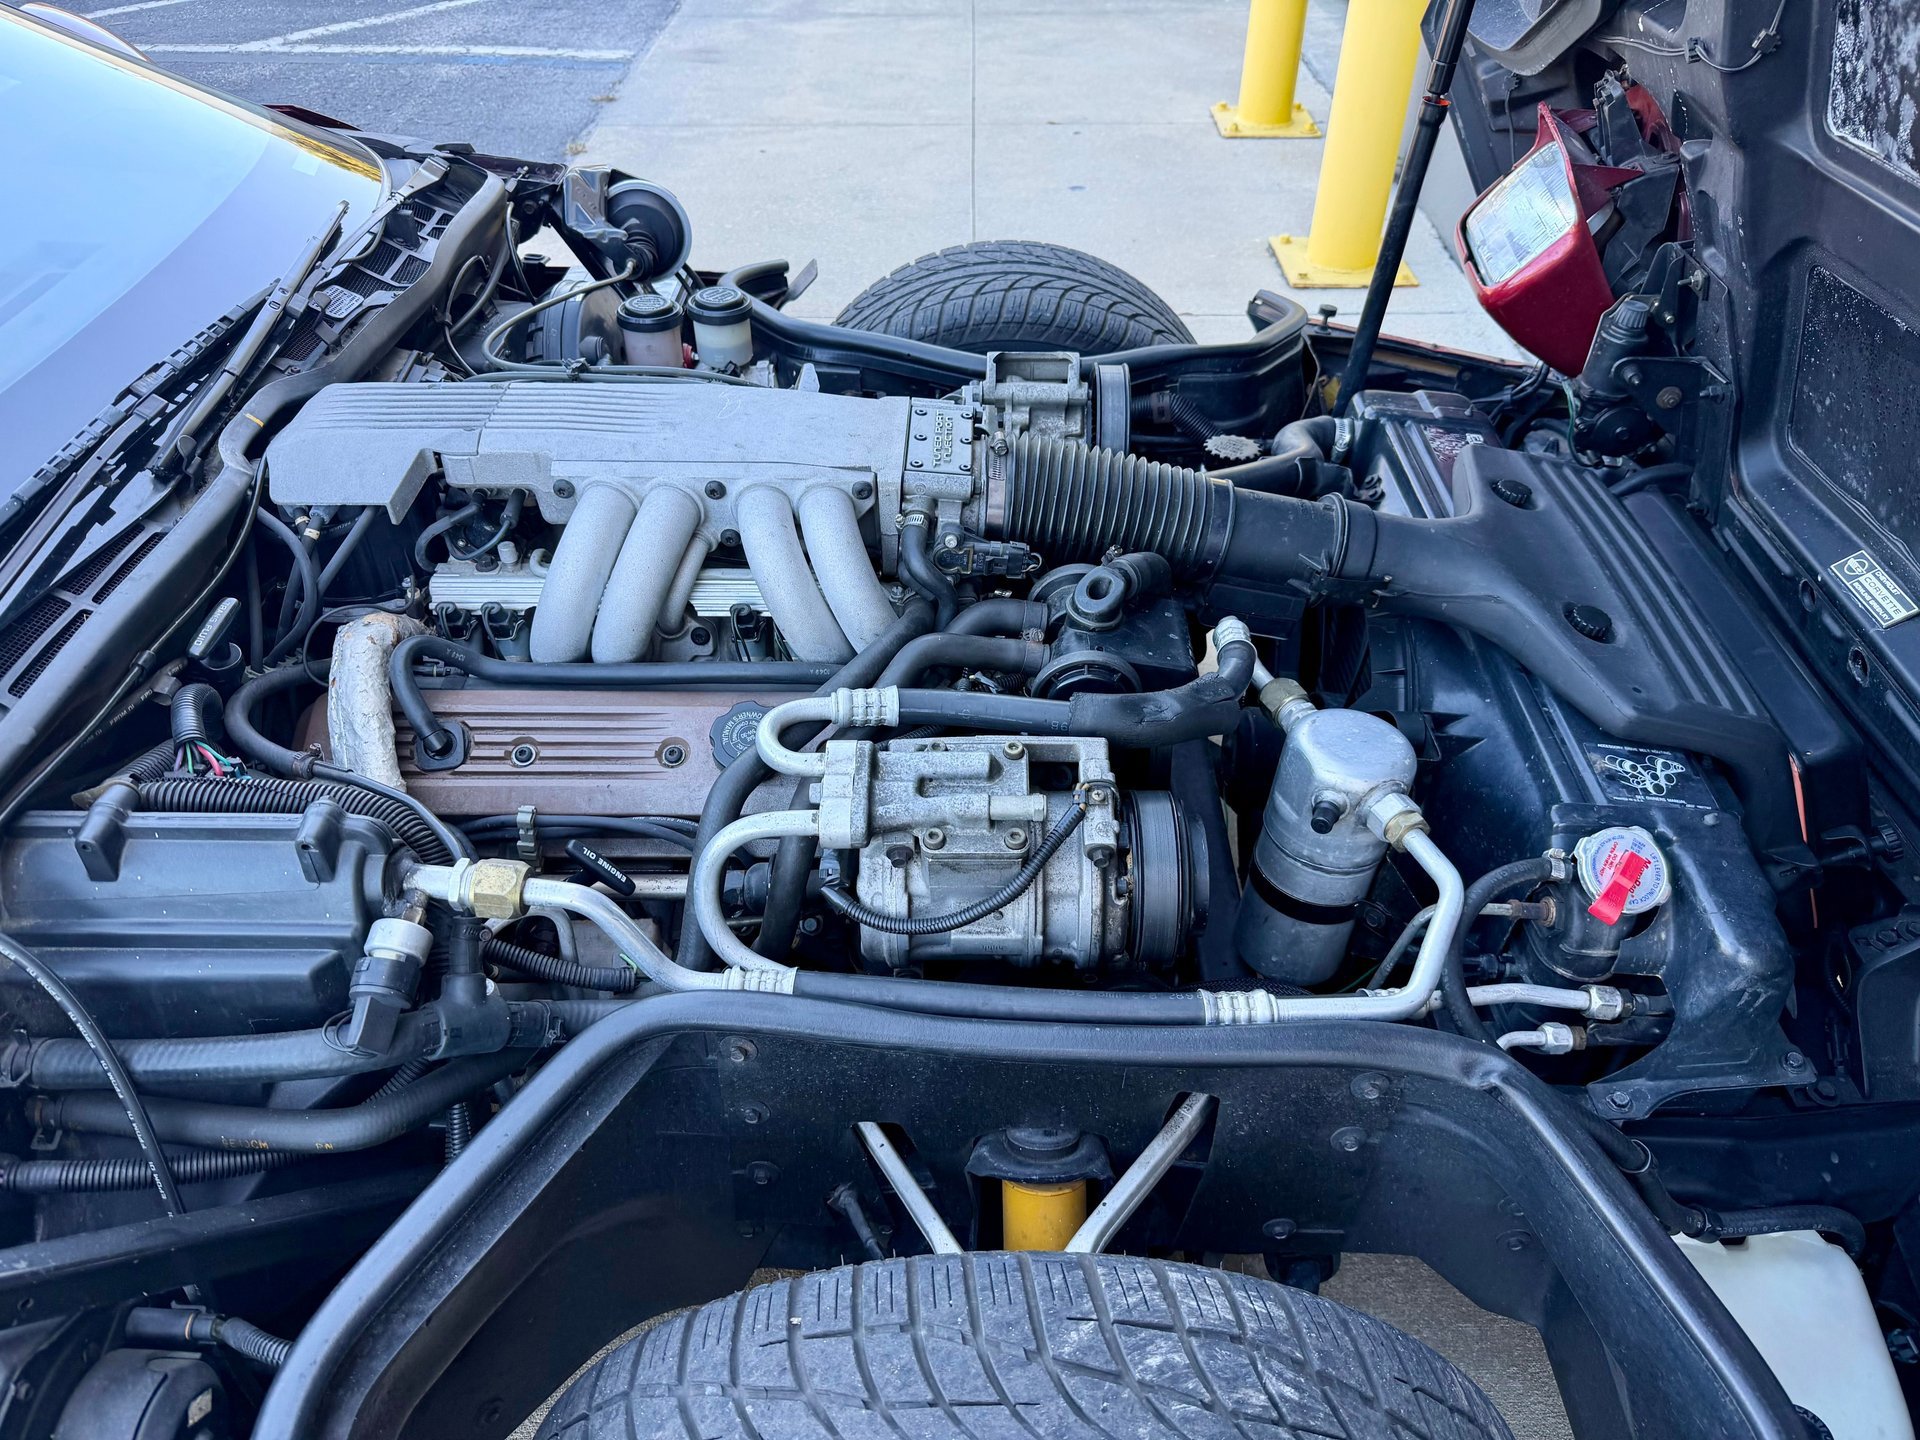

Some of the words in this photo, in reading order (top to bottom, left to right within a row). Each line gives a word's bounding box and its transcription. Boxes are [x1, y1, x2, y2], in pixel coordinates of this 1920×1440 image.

[935, 410, 944, 433] PORT
[943, 416, 953, 463] INJECTION
[933, 436, 942, 467] TUNED
[1875, 571, 1900, 596] CHEVROLET
[1864, 576, 1902, 616] CORVETTE
[209, 600, 231, 623] TRANS
[193, 624, 213, 646] FLUID
[732, 711, 763, 722] OWNER'S
[721, 720, 735, 745] MANUAL
[582, 846, 597, 860] OIL
[1609, 841, 1619, 855] OPEN
[1611, 853, 1618, 862] DO
[1649, 852, 1658, 864] LIFT
[597, 857, 627, 883] ENGINE
[1603, 853, 1613, 867] WHEN
[1607, 861, 1615, 871] NOT
[1653, 863, 1662, 881] LEVER
[1641, 889, 1656, 903] UNLOCK
[153, 1173, 168, 1200] EPDM
